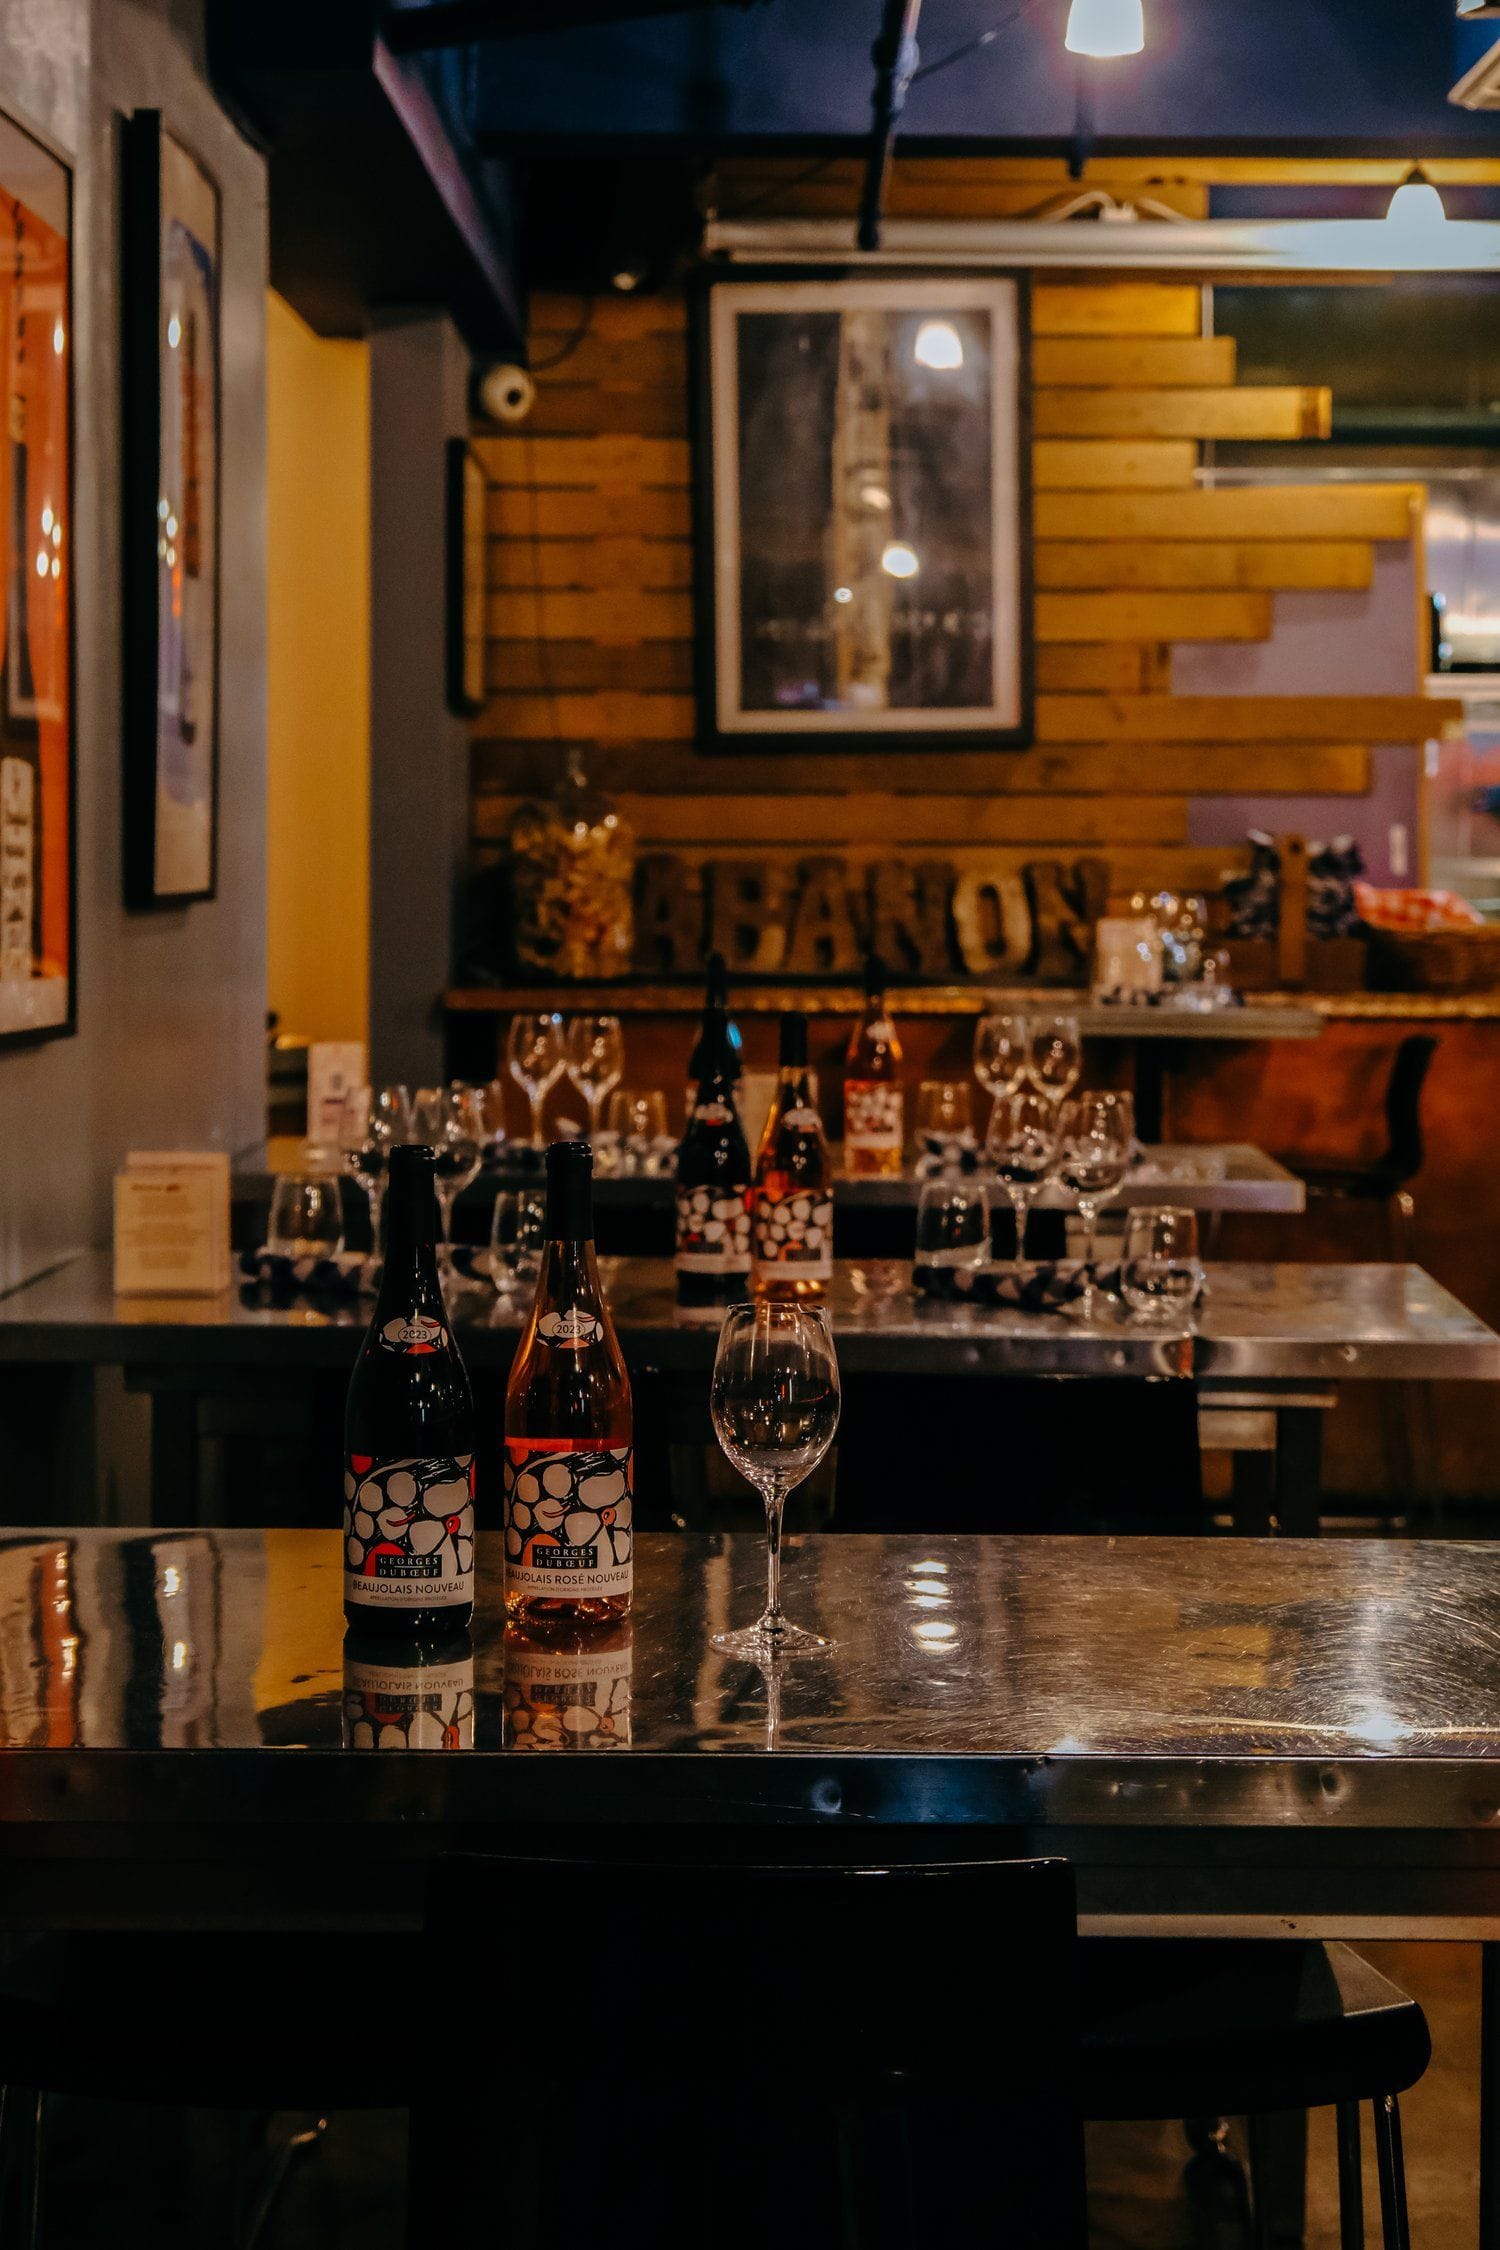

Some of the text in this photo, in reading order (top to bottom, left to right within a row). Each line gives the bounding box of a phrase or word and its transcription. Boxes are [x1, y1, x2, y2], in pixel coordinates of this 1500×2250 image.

[557, 1324, 581, 1334] 2023
[402, 1330, 428, 1340] 2023
[536, 1547, 594, 1556] GEORGES
[379, 1557, 439, 1566] GEORGES
[554, 1572, 585, 1585] ROSÉ
[587, 1570, 629, 1584] NOUVEAU
[353, 1579, 465, 1594] BEAUJOLAIS NOUVEAU
